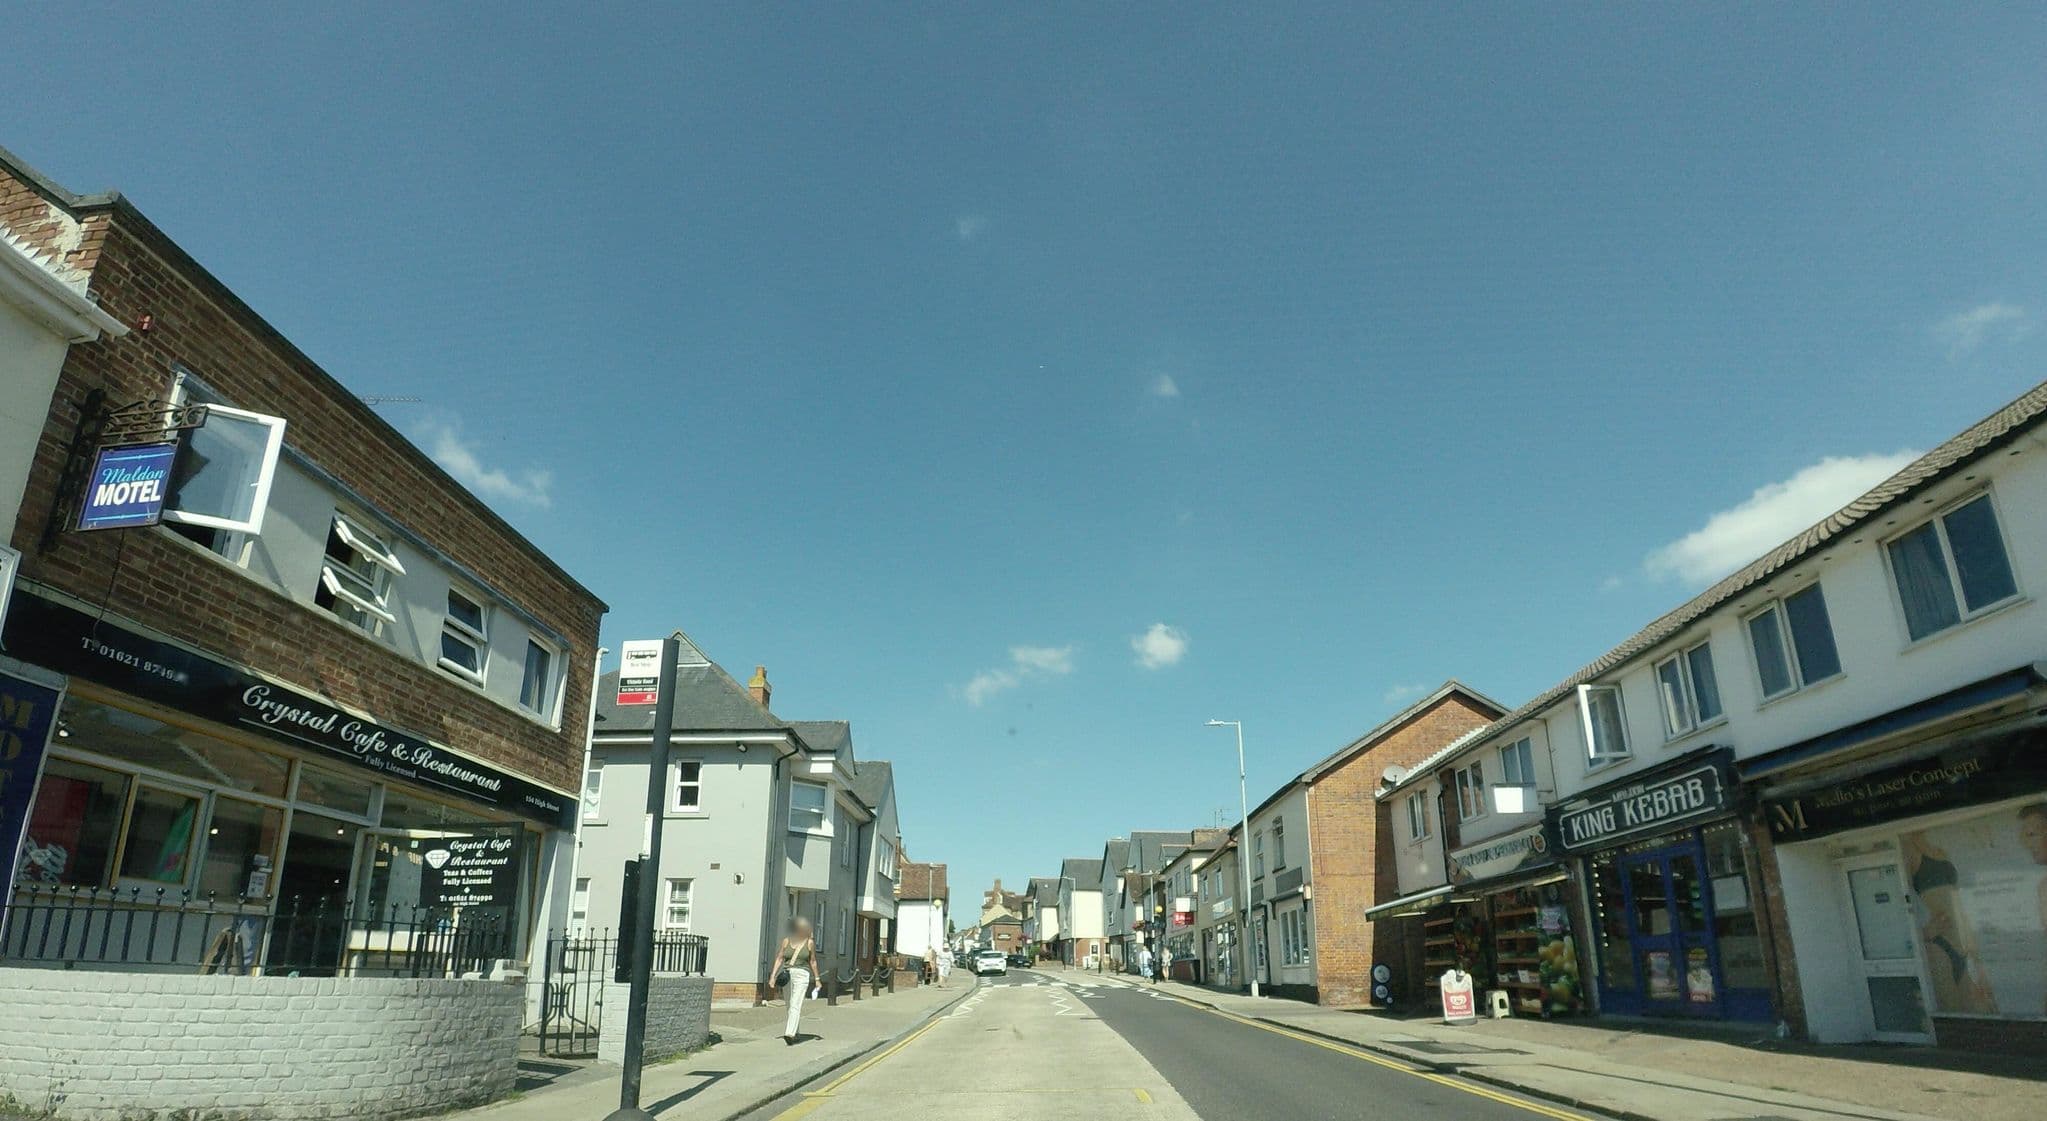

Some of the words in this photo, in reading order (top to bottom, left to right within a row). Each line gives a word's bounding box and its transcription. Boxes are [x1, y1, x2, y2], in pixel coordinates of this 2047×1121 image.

[102, 465, 167, 484] Maldon
[92, 479, 161, 507] MOTEL
[99, 645, 140, 667] 01621
[242, 685, 339, 734] Crystal
[340, 721, 389, 754] Cafe
[391, 743, 409, 761] &
[411, 746, 501, 792] Restaurant
[364, 754, 385, 770] Fully
[386, 759, 417, 779] Licensed
[1909, 757, 1982, 787] Concept
[1571, 806, 1616, 841] KING
[1623, 778, 1704, 826] KEBAB
[450, 840, 489, 853] Crystal
[490, 839, 512, 852] Cafe
[475, 849, 484, 858] &
[450, 856, 508, 866] Restaurant
[462, 877, 492, 885] Licensed
